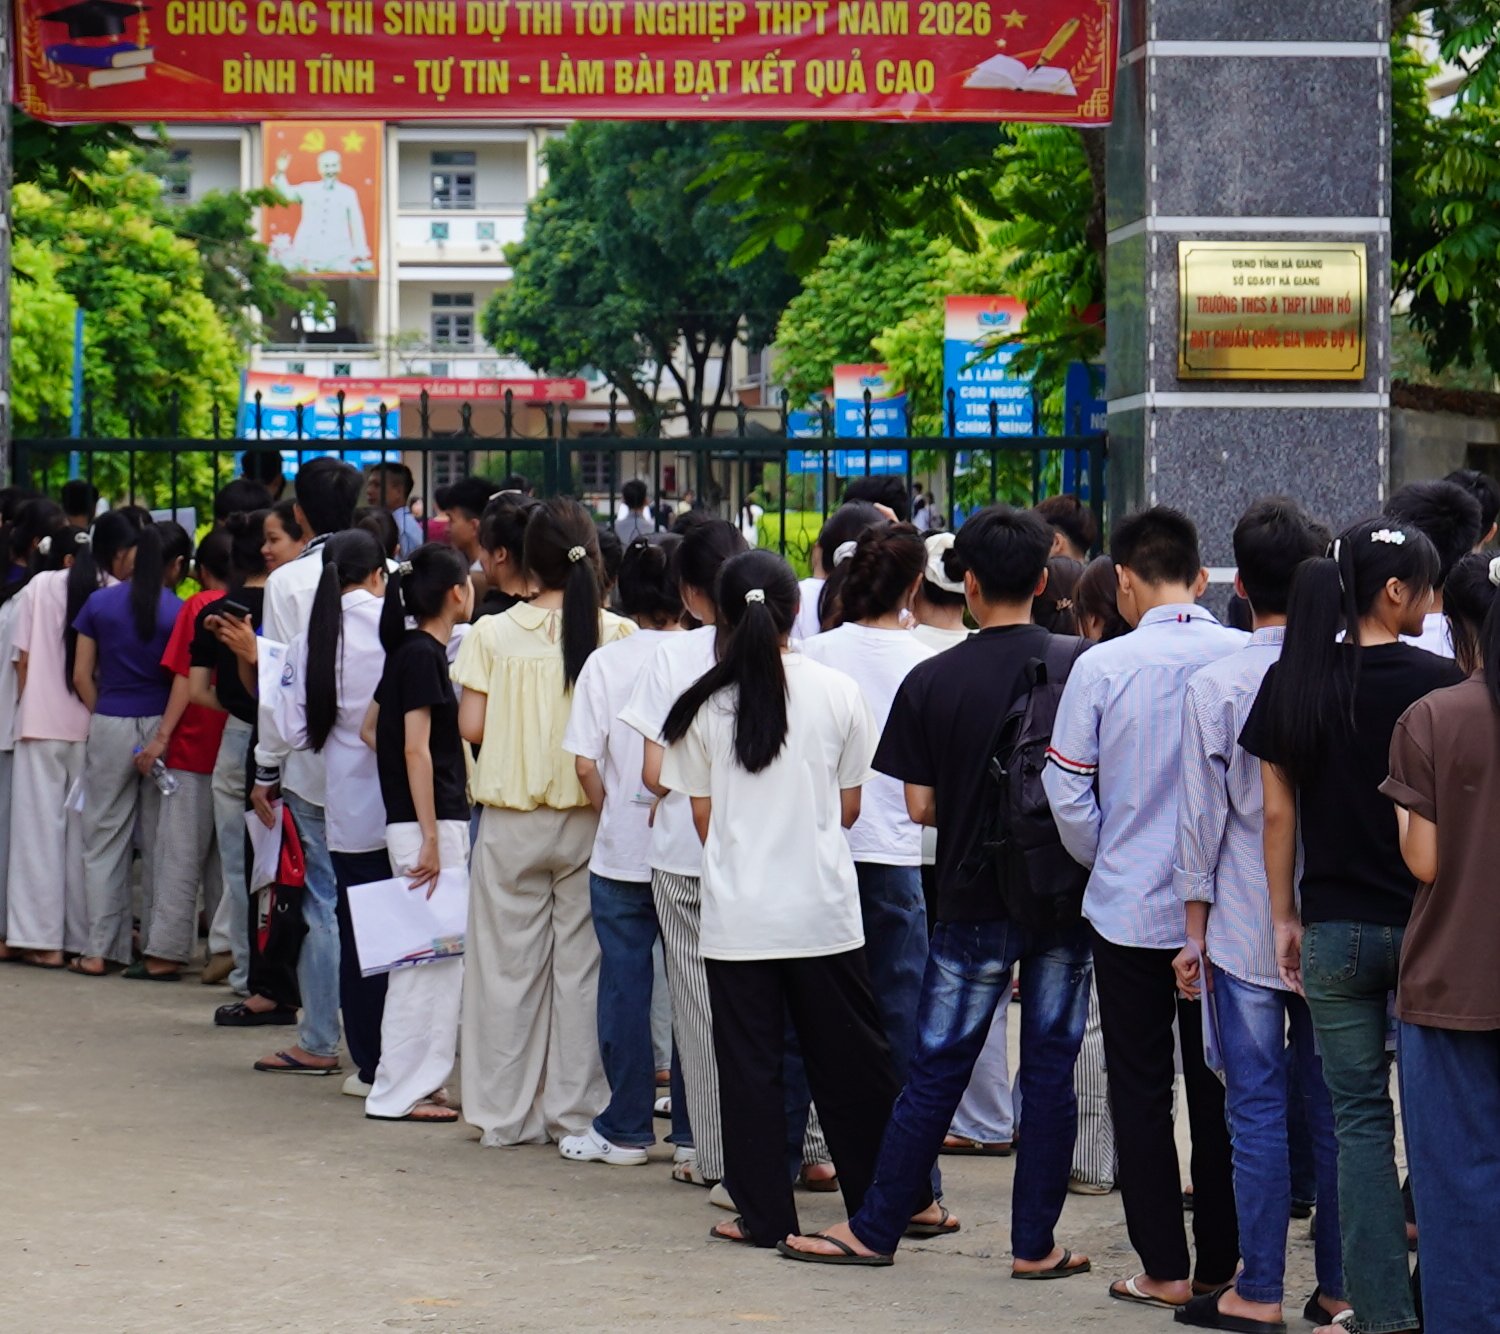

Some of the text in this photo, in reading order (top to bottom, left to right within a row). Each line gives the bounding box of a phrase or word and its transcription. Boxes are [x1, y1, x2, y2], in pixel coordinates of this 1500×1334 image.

[383, 0, 457, 36] SINH
[515, 0, 563, 36] THI
[755, 0, 830, 36] THPT
[917, 0, 992, 36] 2026
[222, 47, 936, 103] BÌNH TĨNH TỰ TIN LÀM BÀI ĐẠT KẾT QUẢ CAO
[1232, 256, 1323, 270] UBND TỈNH HÀ GIANG
[1232, 275, 1245, 287] SỞ
[1279, 274, 1292, 287] HÀ
[1293, 277, 1321, 287] GIANG
[1196, 292, 1239, 314] TRƯỜNG
[1241, 296, 1268, 314] THCS
[1270, 297, 1278, 314] &
[1282, 296, 1308, 315] THPT
[1310, 296, 1334, 314] LINH
[1190, 329, 1211, 352] ĐẠT
[1213, 322, 1250, 348] CHUẨN
[1252, 323, 1281, 350] QUỐC
[1283, 330, 1301, 348] GIA
[1304, 327, 1329, 348] MỨC
